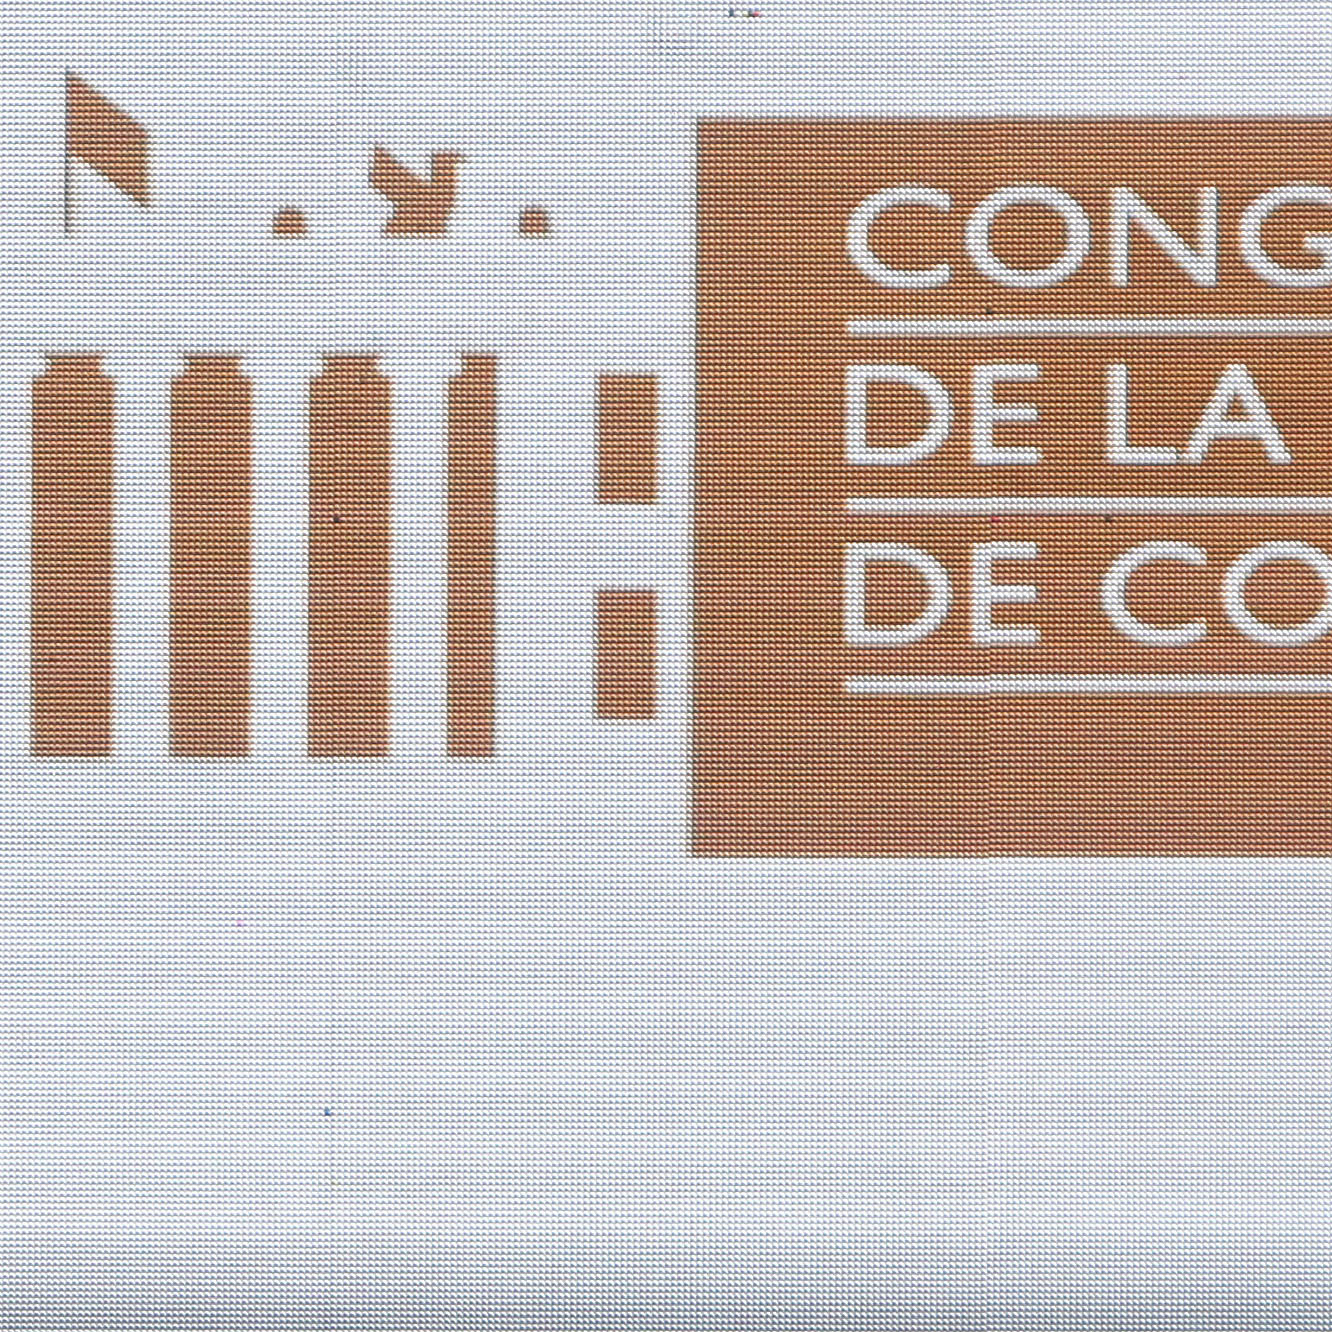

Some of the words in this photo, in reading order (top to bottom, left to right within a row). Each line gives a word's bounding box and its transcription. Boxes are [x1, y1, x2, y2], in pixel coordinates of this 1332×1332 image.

[845, 181, 1332, 288] CONG
[844, 364, 1043, 466] DE
[1106, 364, 1293, 466] LA
[844, 541, 1043, 648] DE
[1101, 541, 1332, 648] CO
